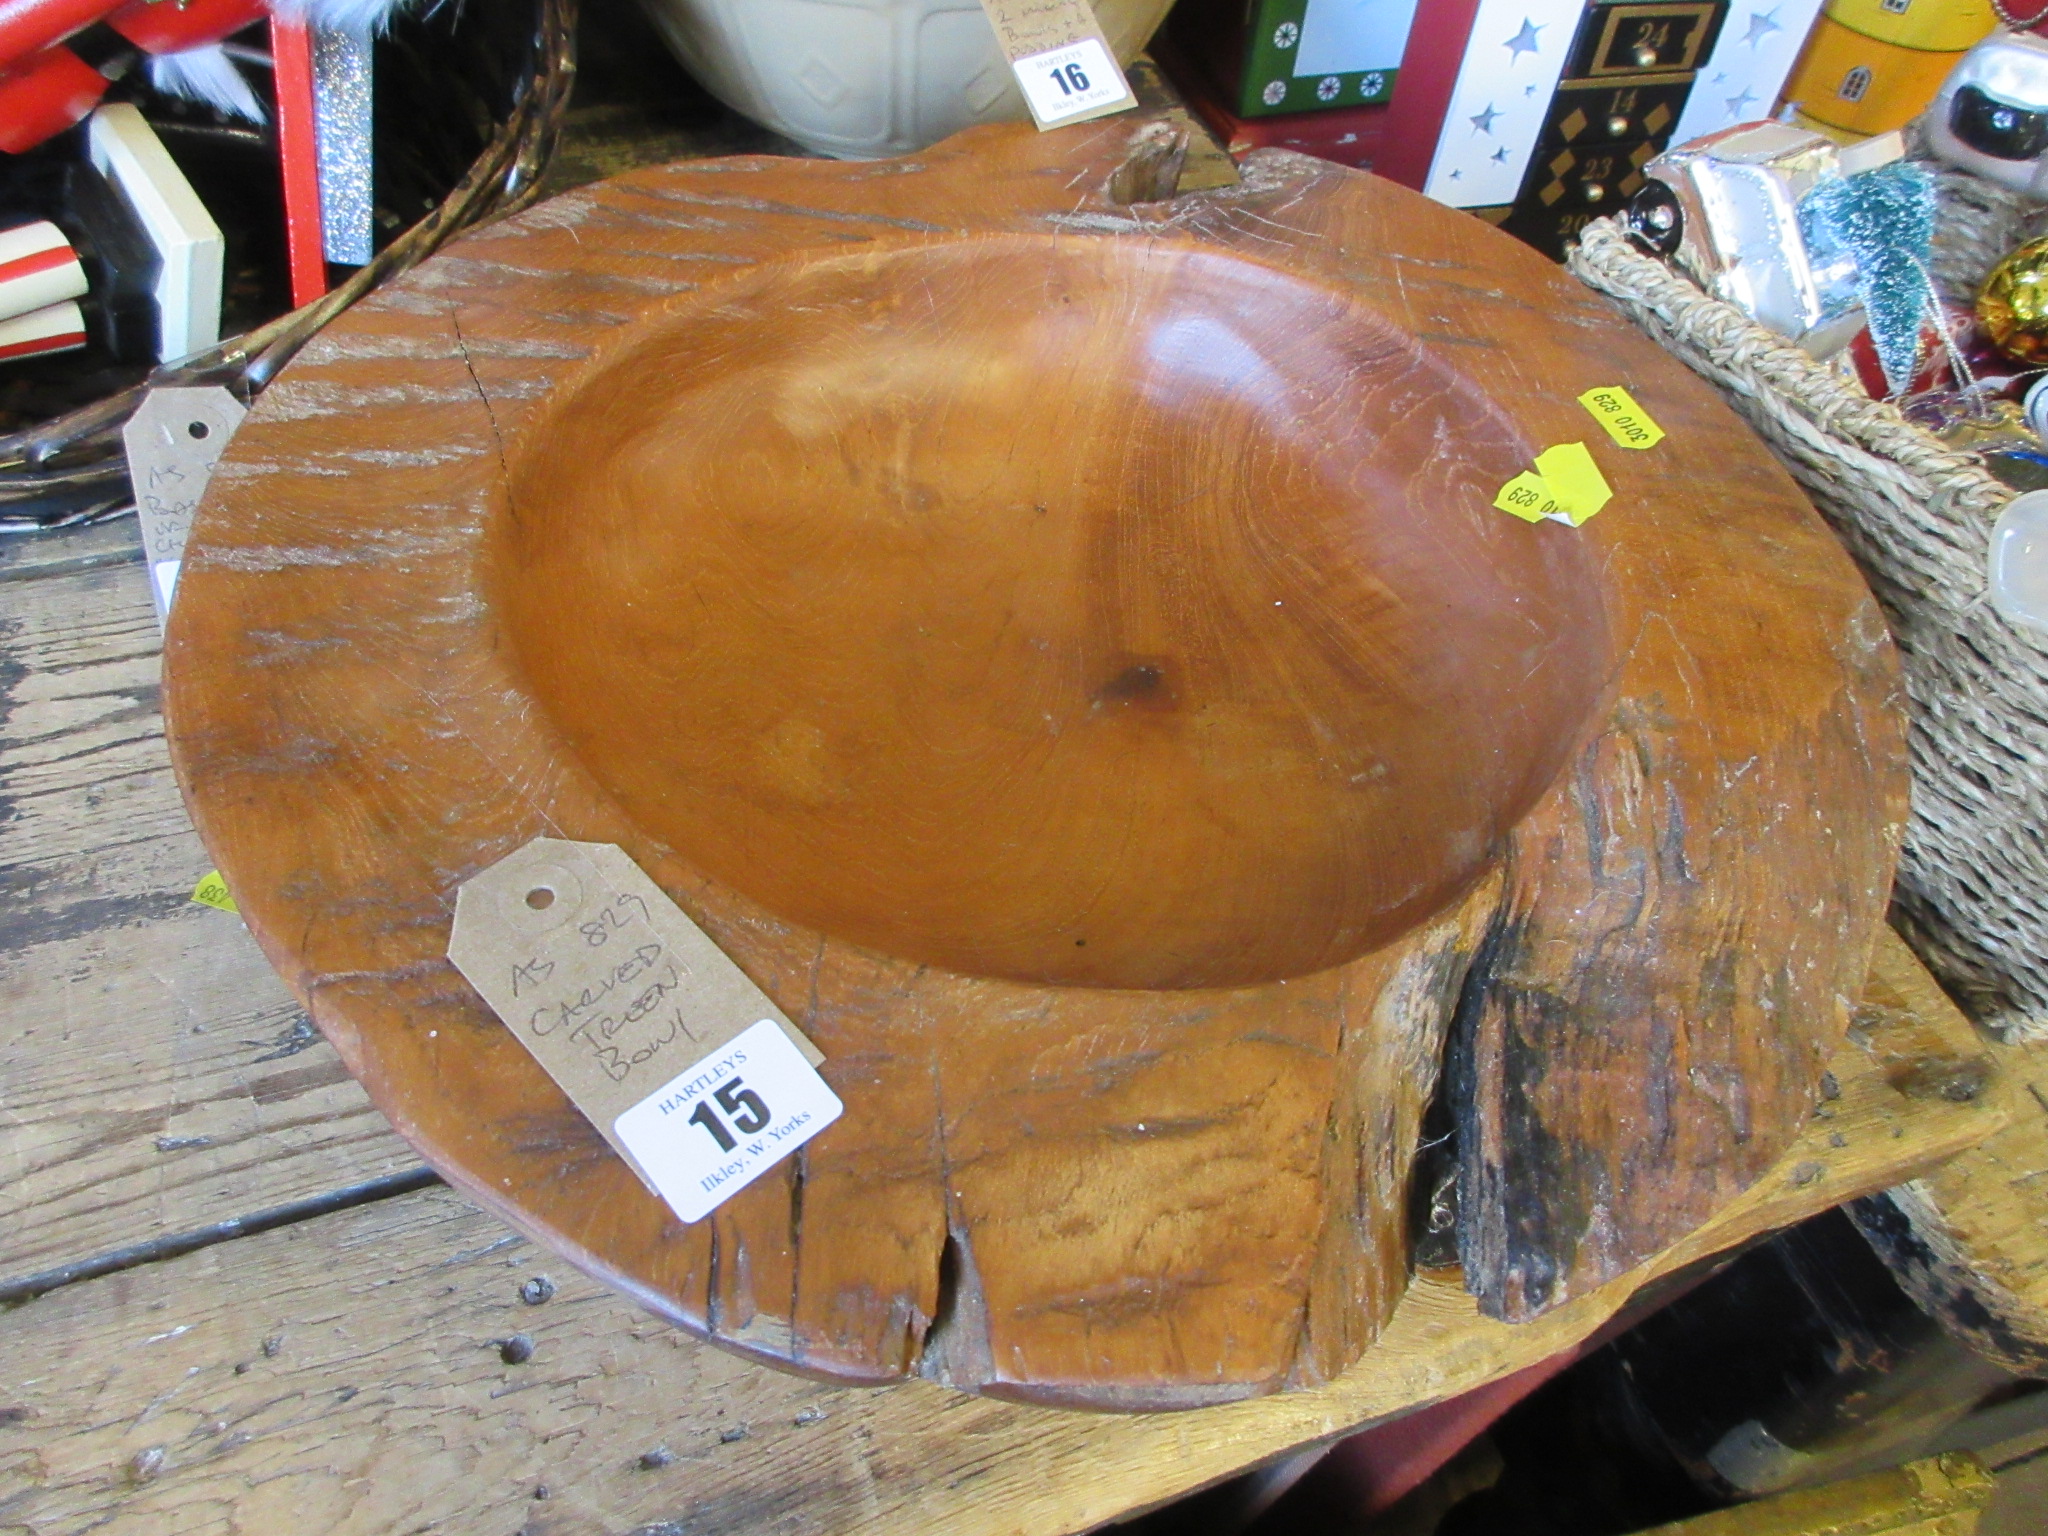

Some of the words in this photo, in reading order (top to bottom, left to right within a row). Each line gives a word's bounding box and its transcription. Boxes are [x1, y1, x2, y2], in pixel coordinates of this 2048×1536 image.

[1633, 22, 1671, 49] 24
[1036, 50, 1083, 70] HARTLEYS
[1050, 63, 1091, 96] 16
[1089, 88, 1111, 101] Yorks
[1609, 89, 1638, 113] 14
[1581, 158, 1614, 181] 23
[1593, 394, 1622, 413] 829
[1614, 416, 1649, 442] 3010
[1507, 487, 1539, 507] 829
[580, 893, 651, 947] 829
[511, 957, 555, 997] AS
[658, 1050, 748, 1116] HARTLEYS
[688, 1076, 772, 1153] 15
[746, 1132, 773, 1157] W.
[769, 1109, 812, 1144] Yorks
